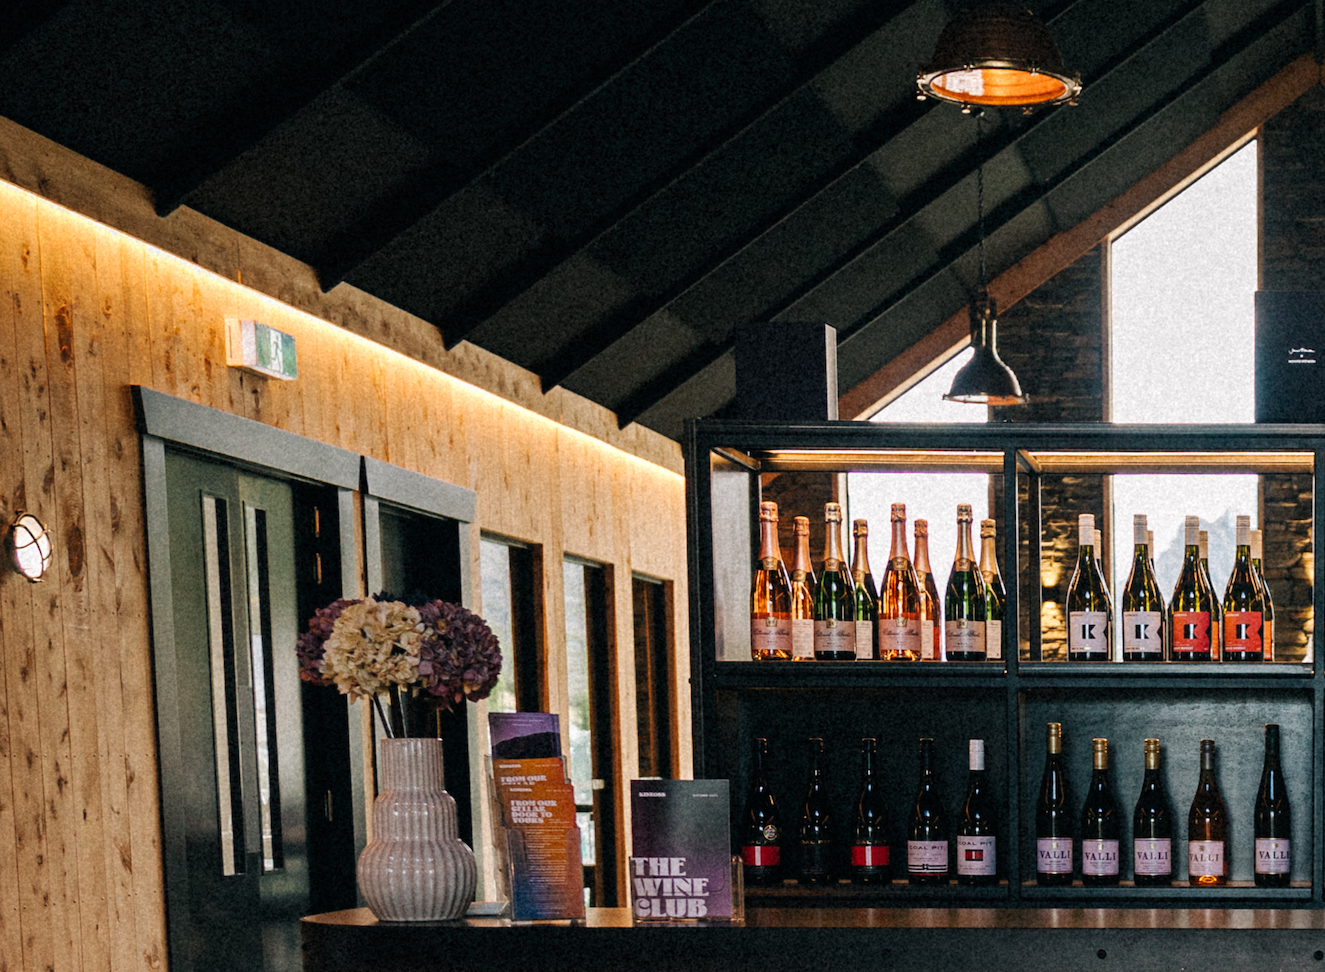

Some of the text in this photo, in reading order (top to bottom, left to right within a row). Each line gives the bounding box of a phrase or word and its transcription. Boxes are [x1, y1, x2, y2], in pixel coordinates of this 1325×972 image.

[1040, 851, 1070, 859] VALLI
[1137, 852, 1168, 860] VALLI
[1259, 851, 1290, 859] VALLI
[631, 857, 686, 876] THE
[634, 878, 709, 896] WINE
[635, 898, 707, 918] CLUB
